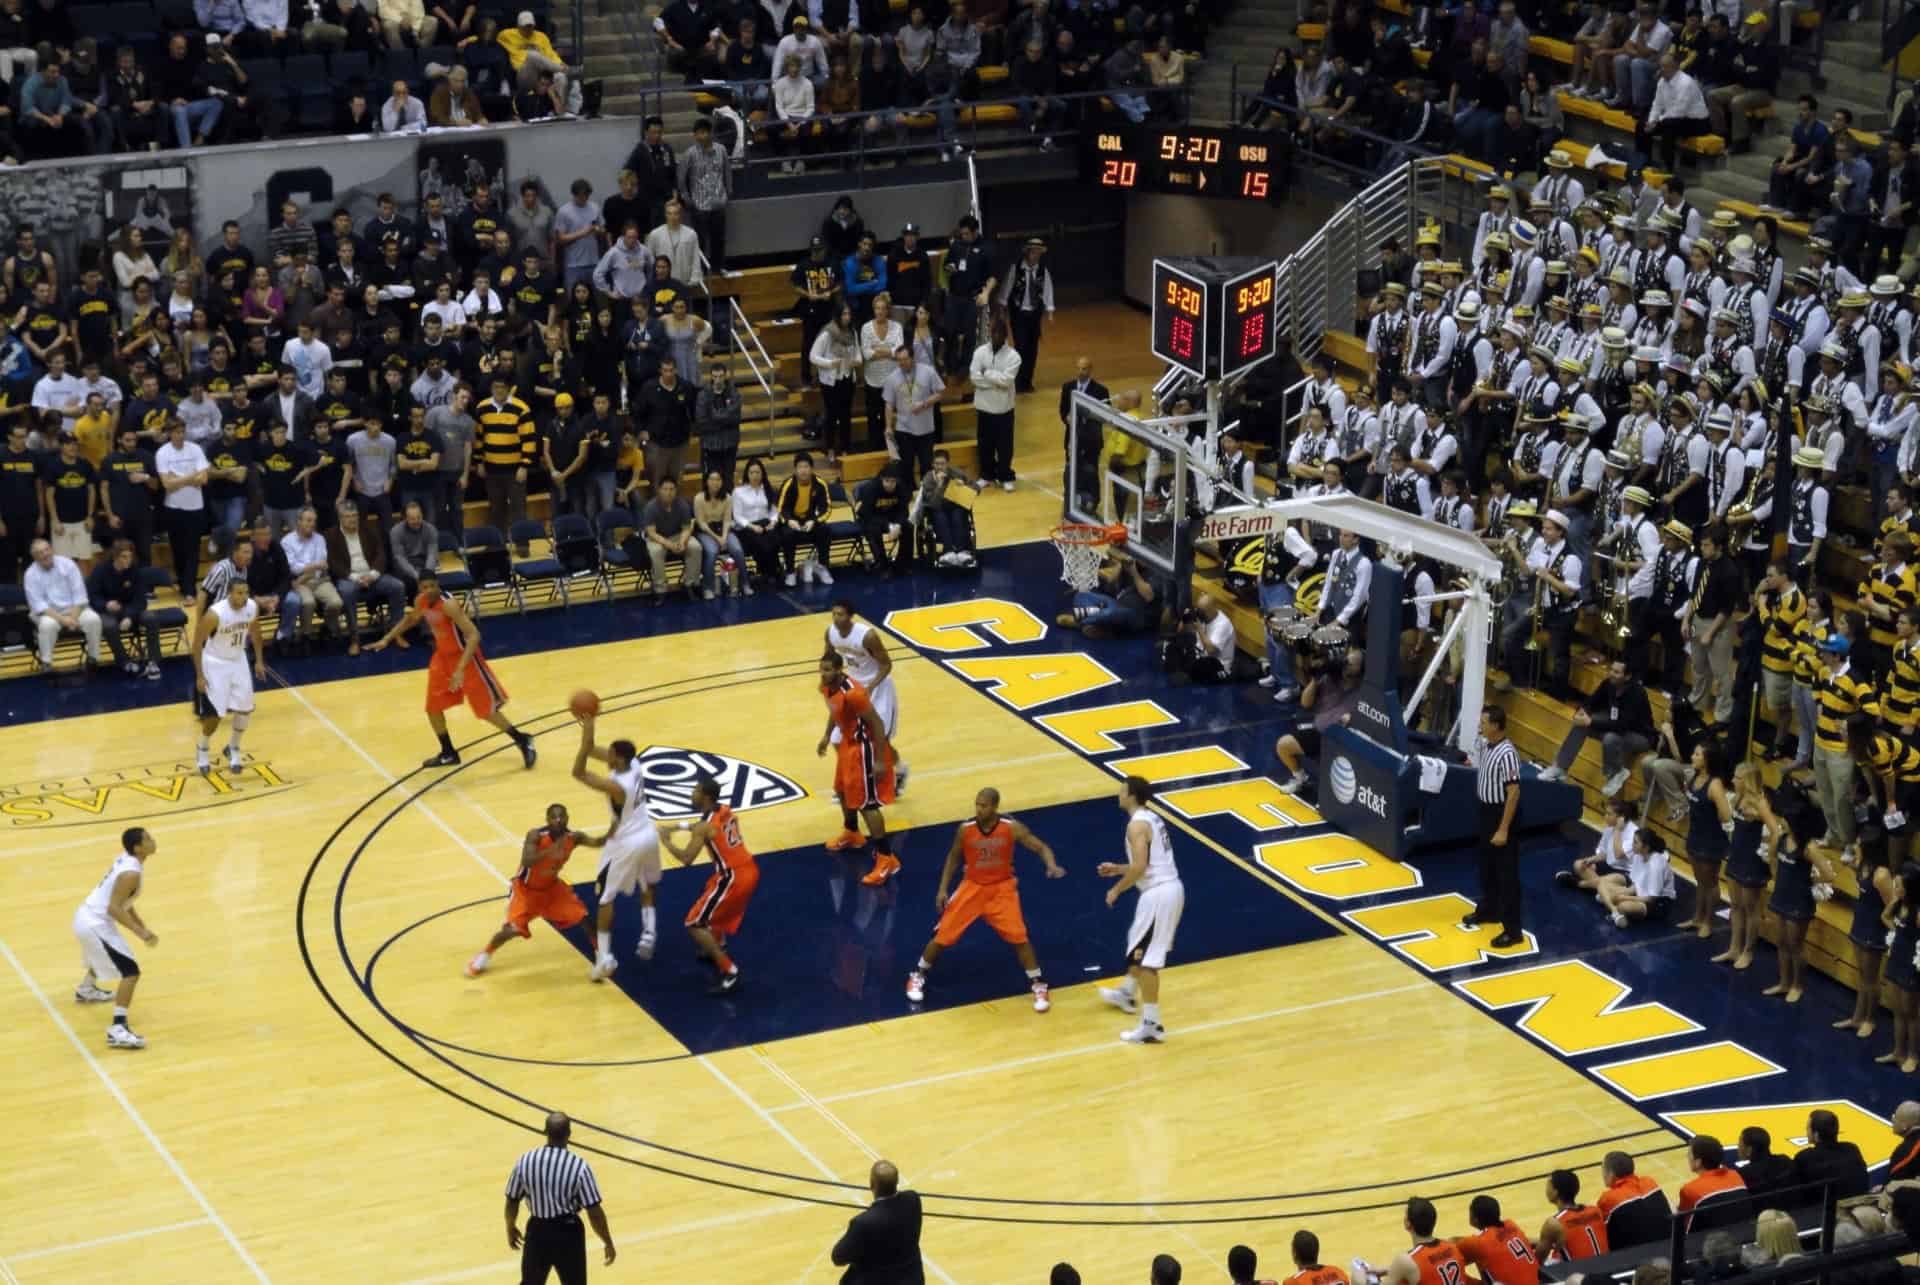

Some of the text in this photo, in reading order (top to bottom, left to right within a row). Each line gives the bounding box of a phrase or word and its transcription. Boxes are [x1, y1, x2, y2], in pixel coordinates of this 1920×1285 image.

[1098, 134, 1122, 151] CAL
[1160, 135, 1221, 164] 9:20
[1239, 146, 1268, 162] OSU
[1102, 160, 1137, 187] 20
[1243, 172, 1270, 198] 15
[1167, 280, 1201, 316] 9:20
[1237, 277, 1272, 313] 9:20
[1200, 515, 1273, 538] ate Farm
[1357, 700, 1391, 728] att.com
[0, 761, 293, 825] HAAS
[1358, 785, 1387, 818] at&t
[884, 597, 1894, 1171] CALIFORNIA
[1507, 1237, 1537, 1264] 4
[1585, 1225, 1600, 1256] 1
[1437, 1259, 1462, 1285] 12
